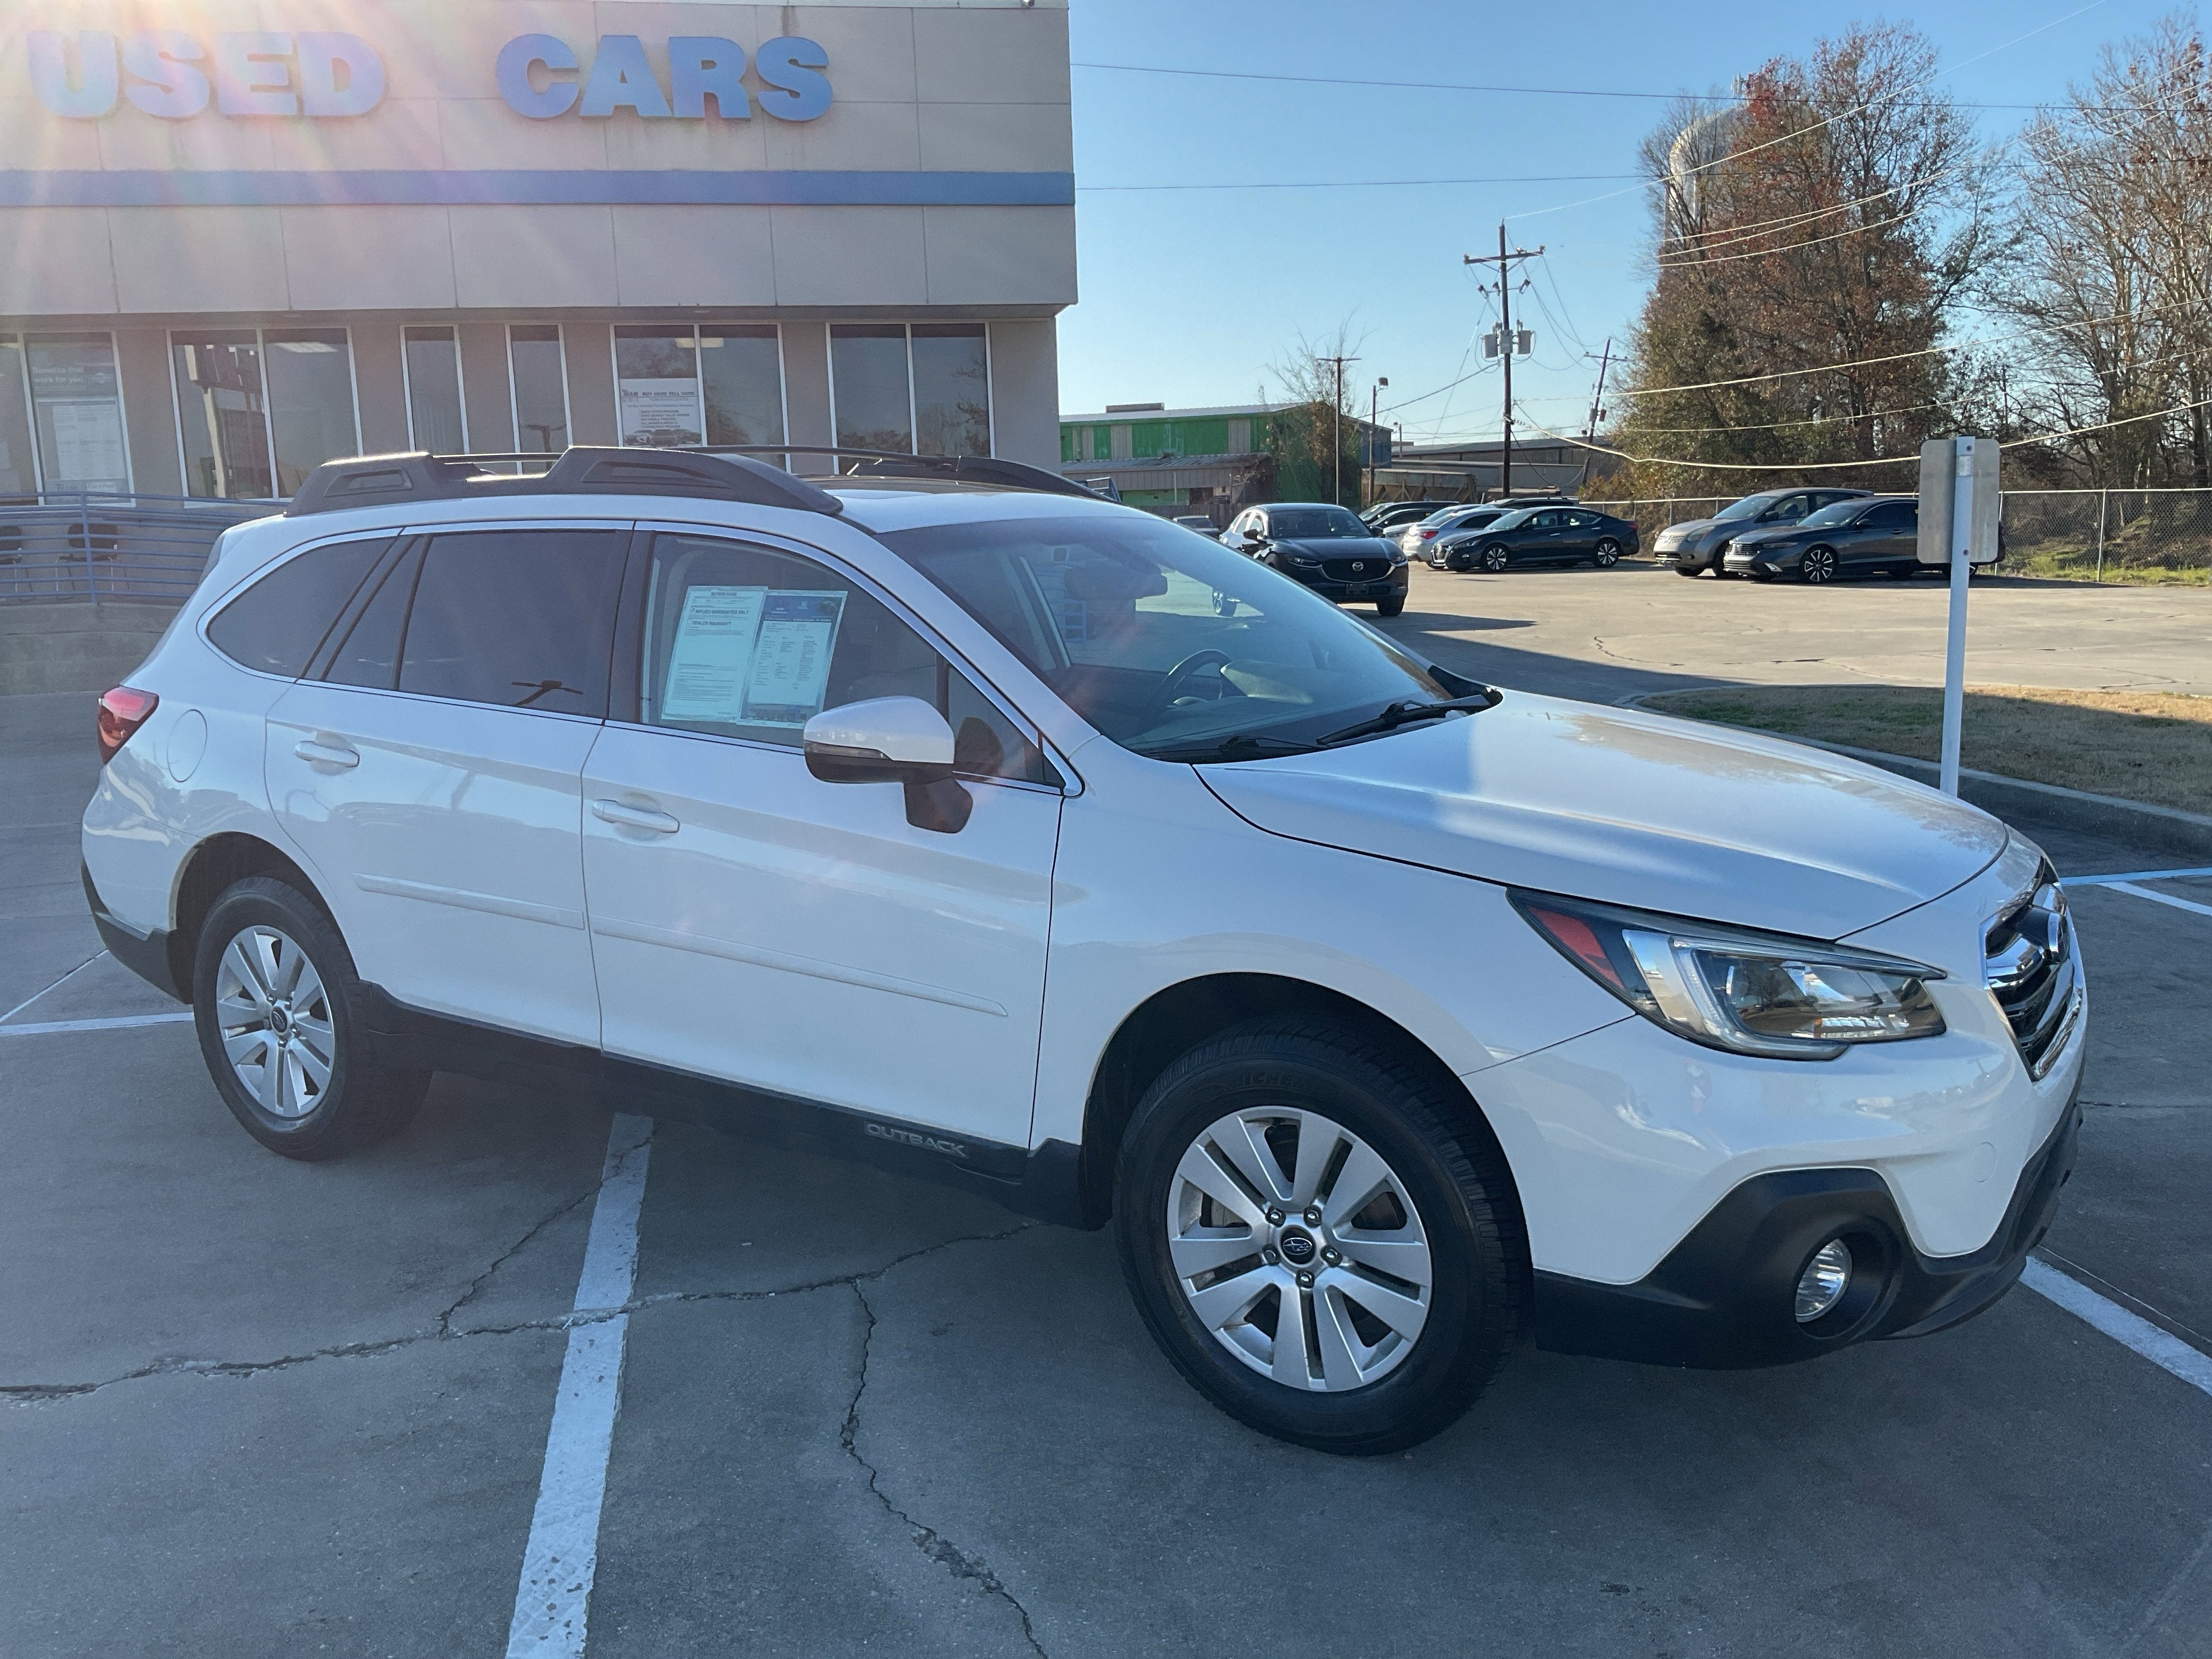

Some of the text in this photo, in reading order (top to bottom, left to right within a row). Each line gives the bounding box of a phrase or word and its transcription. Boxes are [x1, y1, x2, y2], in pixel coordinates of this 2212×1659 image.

[26, 29, 833, 122] USED CARS
[866, 1123, 968, 1159] OUTBACK
